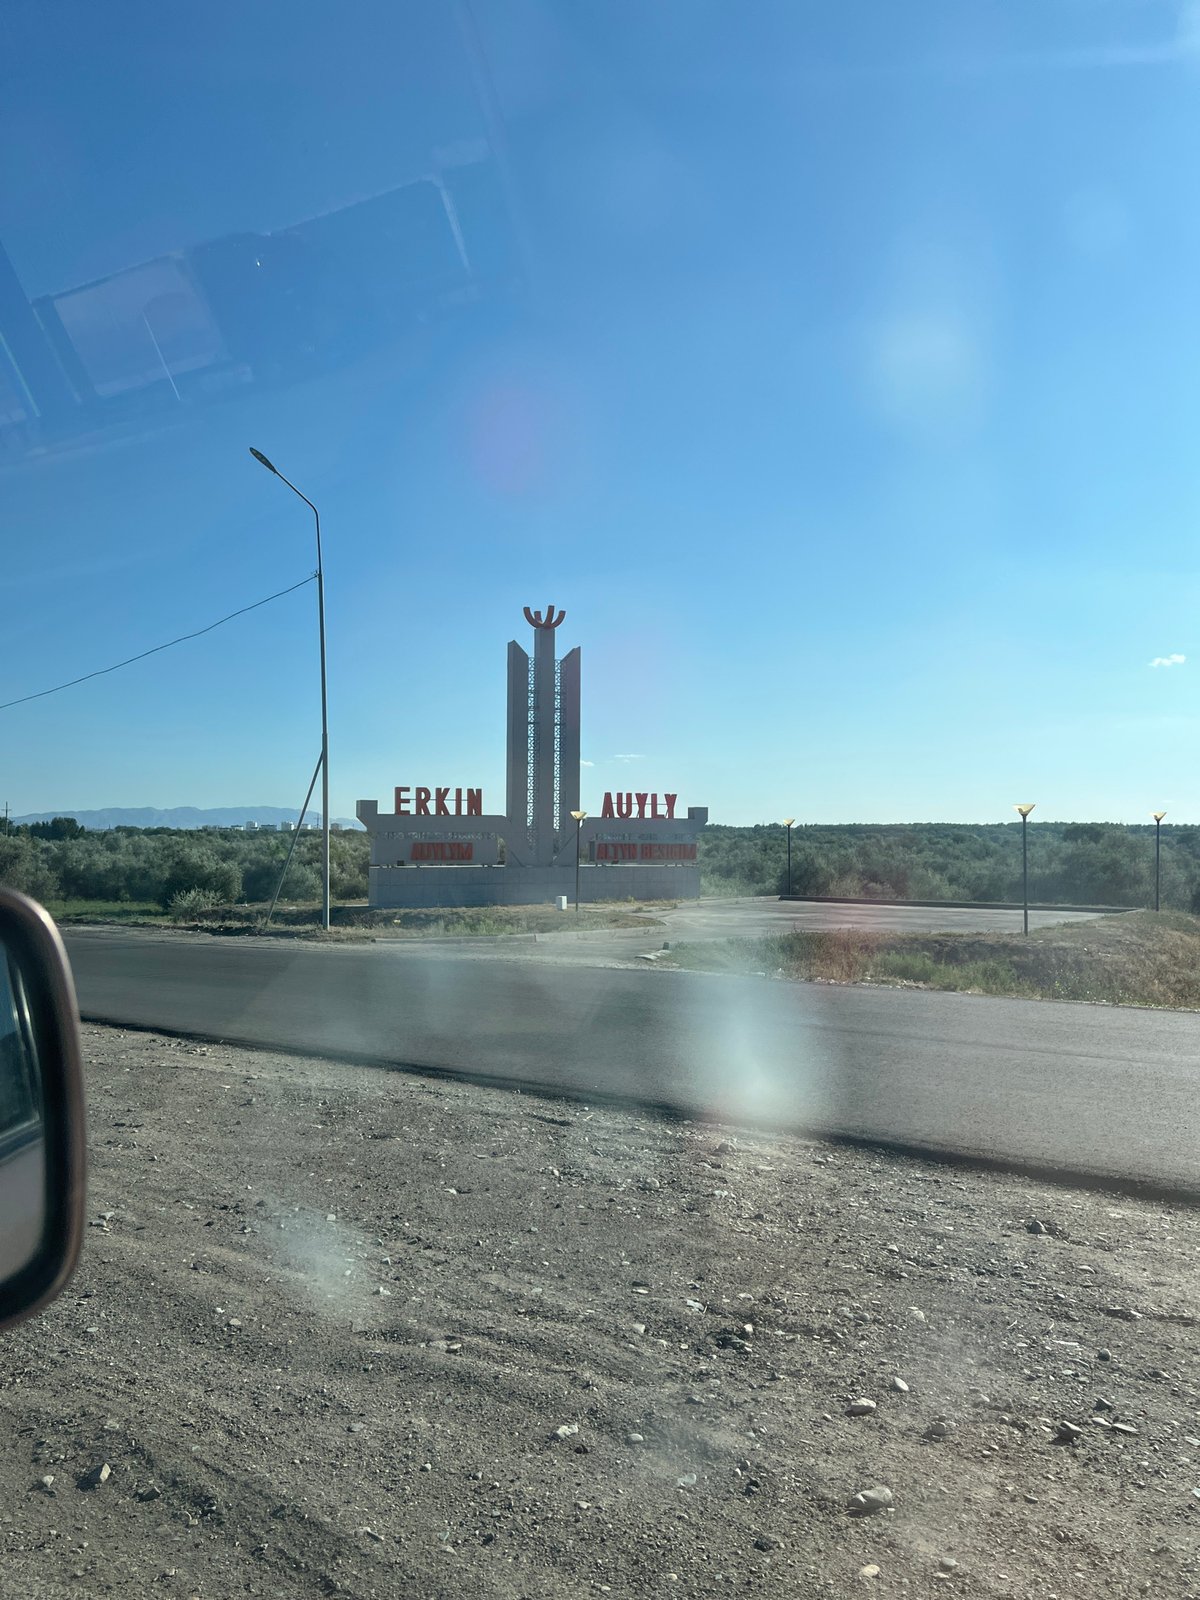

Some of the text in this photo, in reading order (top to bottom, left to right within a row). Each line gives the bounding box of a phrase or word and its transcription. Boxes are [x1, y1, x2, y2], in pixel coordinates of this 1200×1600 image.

[395, 787, 677, 819] ERKIN AUYLY
[411, 842, 473, 861] AUYLYM
[596, 843, 637, 861] ALTYN
